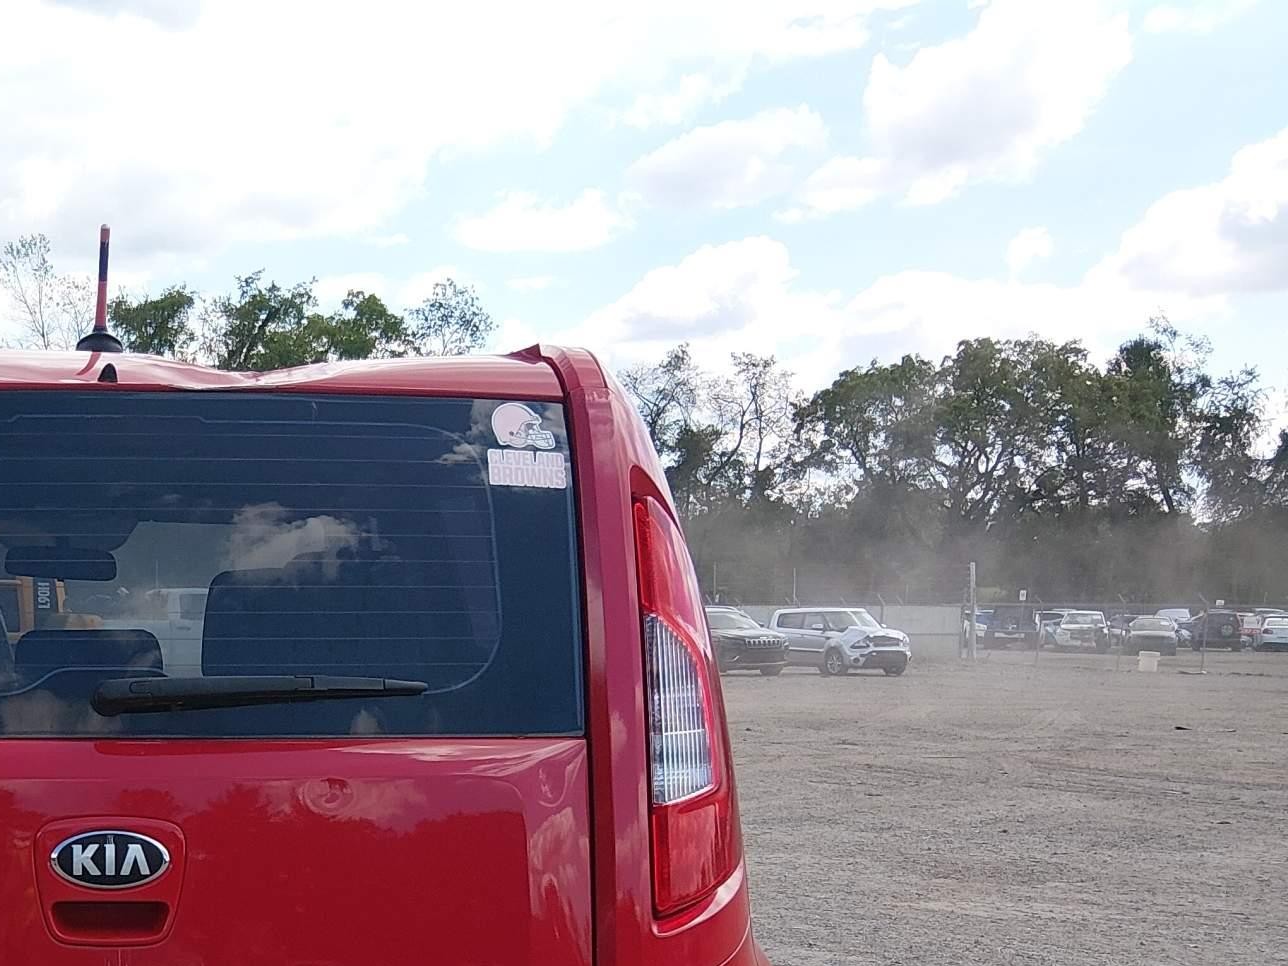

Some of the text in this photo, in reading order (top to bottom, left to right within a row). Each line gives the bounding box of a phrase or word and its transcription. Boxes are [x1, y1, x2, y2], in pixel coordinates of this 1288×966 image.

[488, 449, 565, 468] CLEVELAND
[490, 465, 567, 488] BROWNS
[71, 843, 151, 876] KIA
